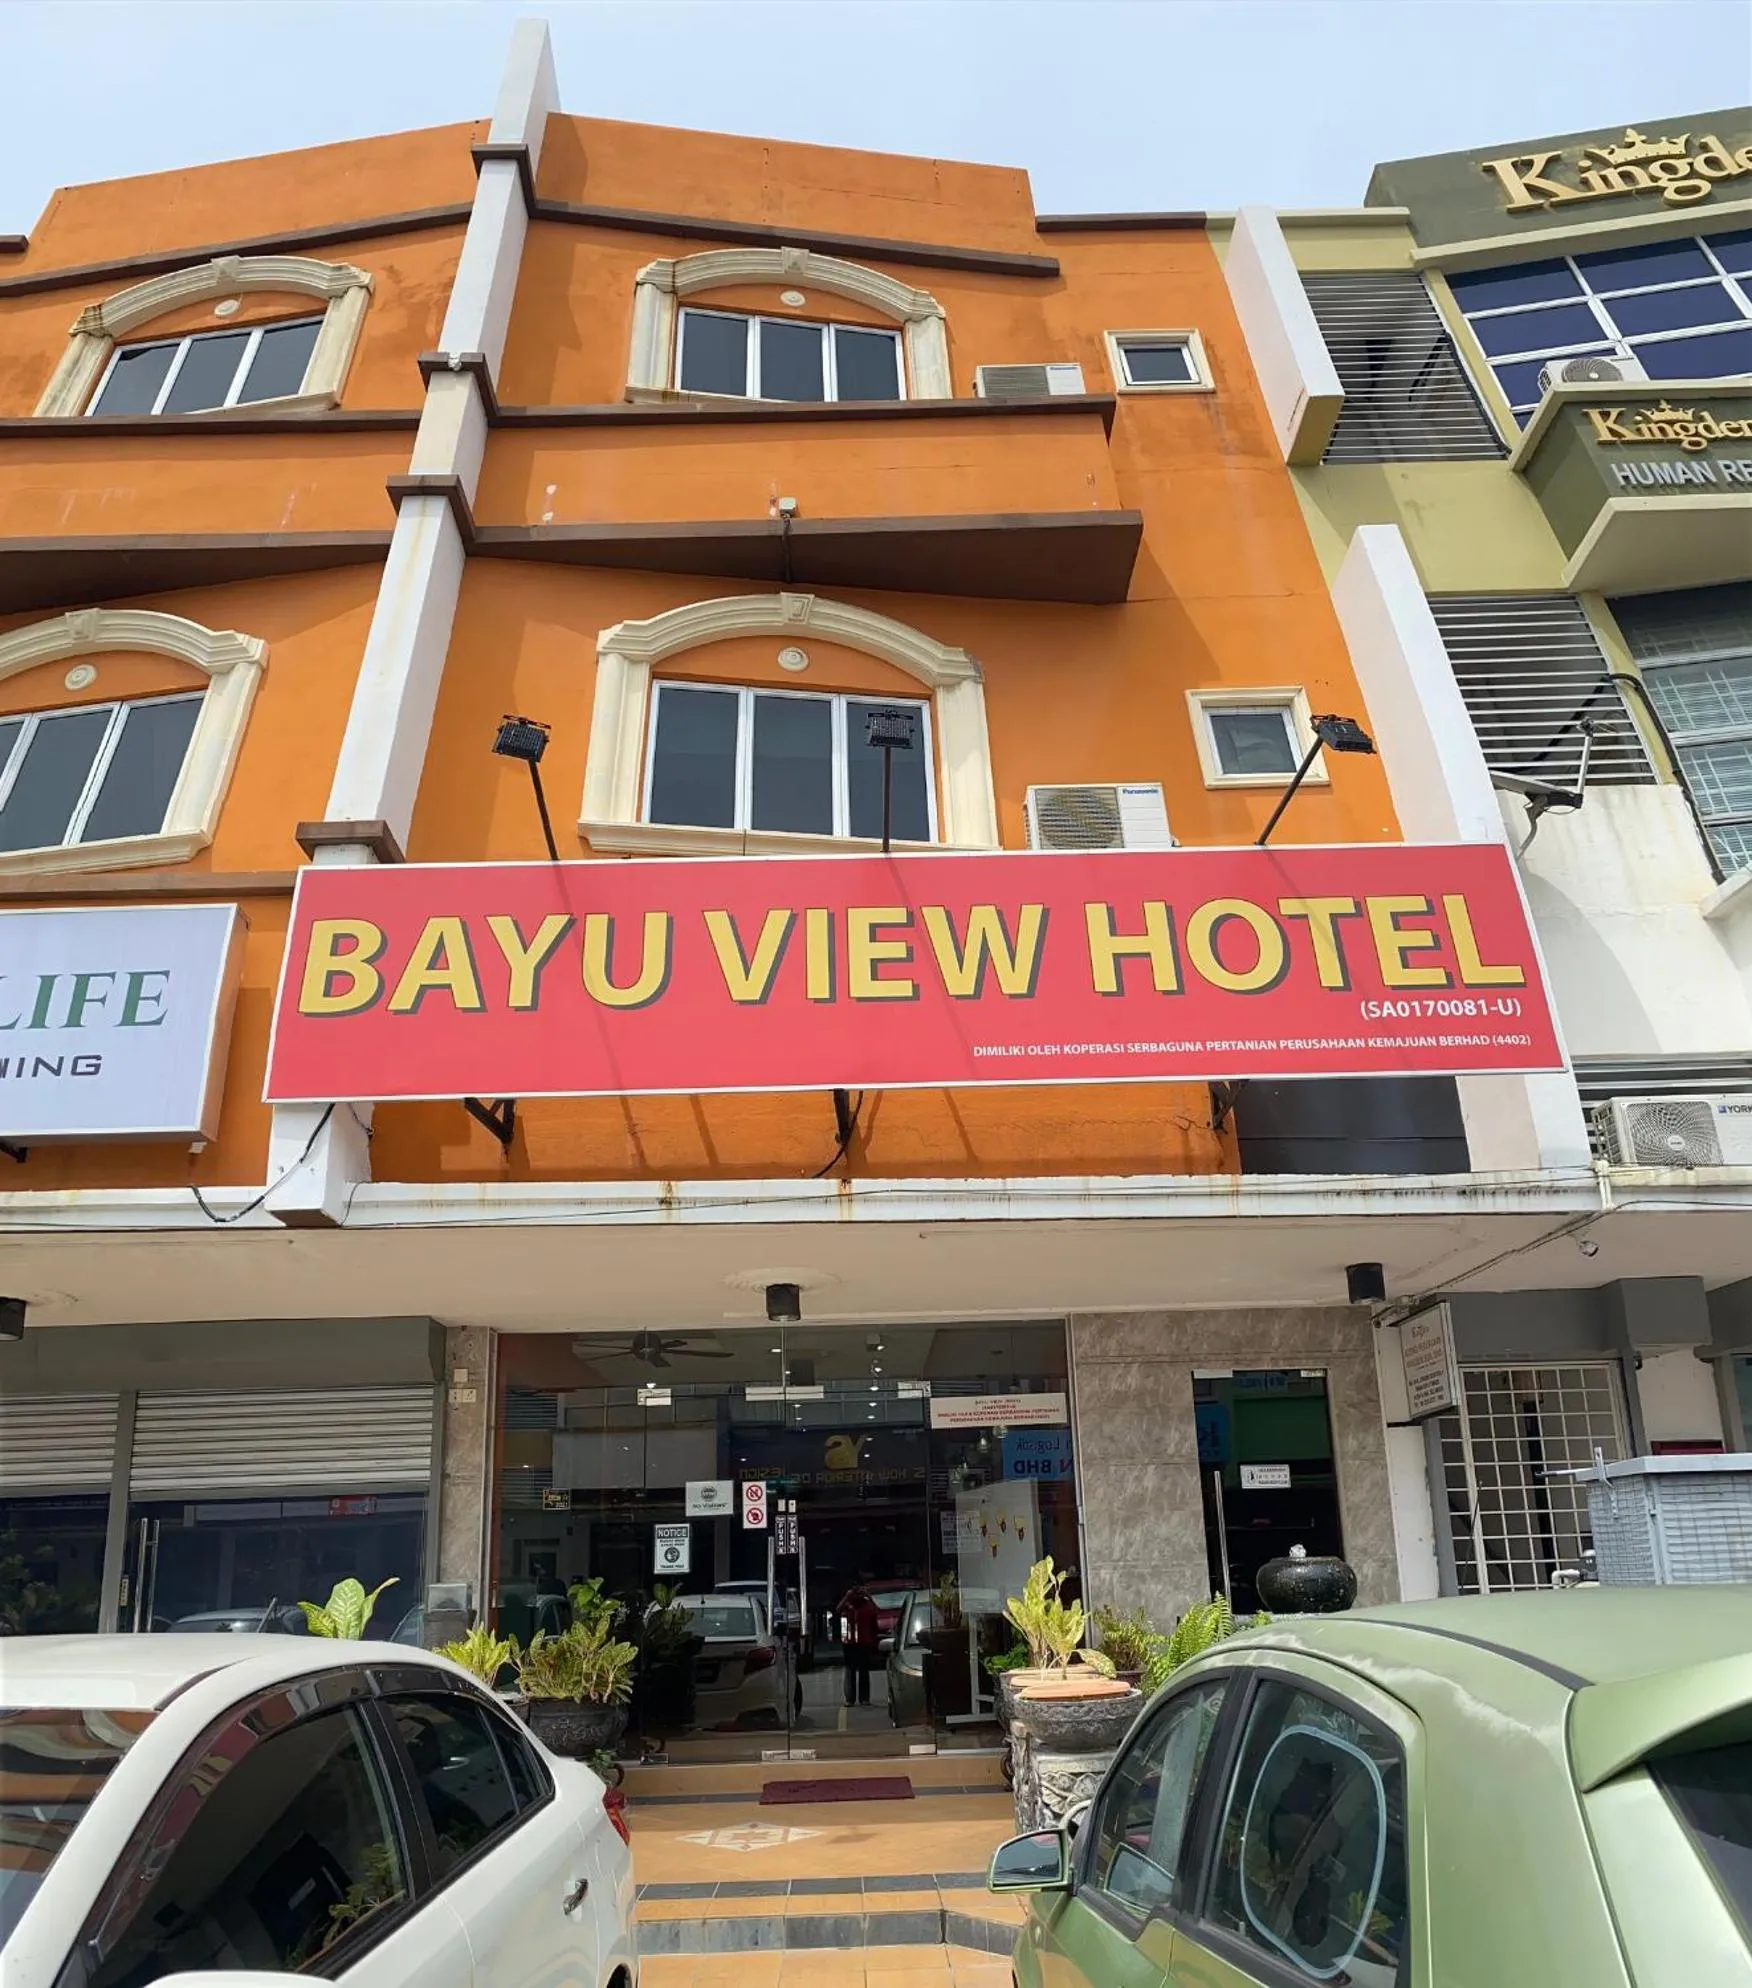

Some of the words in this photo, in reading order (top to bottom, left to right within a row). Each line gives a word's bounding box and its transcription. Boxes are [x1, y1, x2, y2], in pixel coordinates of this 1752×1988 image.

[1610, 460, 1717, 485] HUMAN
[297, 911, 673, 1018] BAYU
[702, 903, 1051, 1005] VIEW
[1084, 894, 1527, 997] HOTEL
[0, 969, 170, 1031] IFE
[1361, 998, 1521, 1020] (SA0170081-U)
[974, 1046, 1024, 1057] DIMILIKI
[1028, 1045, 1060, 1056] OLEH
[1064, 1043, 1124, 1055] KOPERASI
[1127, 1042, 1203, 1053] SERBAGUNA
[1206, 1040, 1277, 1051] PERTANIAN
[1280, 1039, 1365, 1049] PERUSAHAAN
[1368, 1037, 1437, 1048] KEMAJUAN
[1439, 1035, 1490, 1046] BERHAD
[1493, 1034, 1531, 1046] (4402)
[658, 1528, 687, 1538] NOTICE
